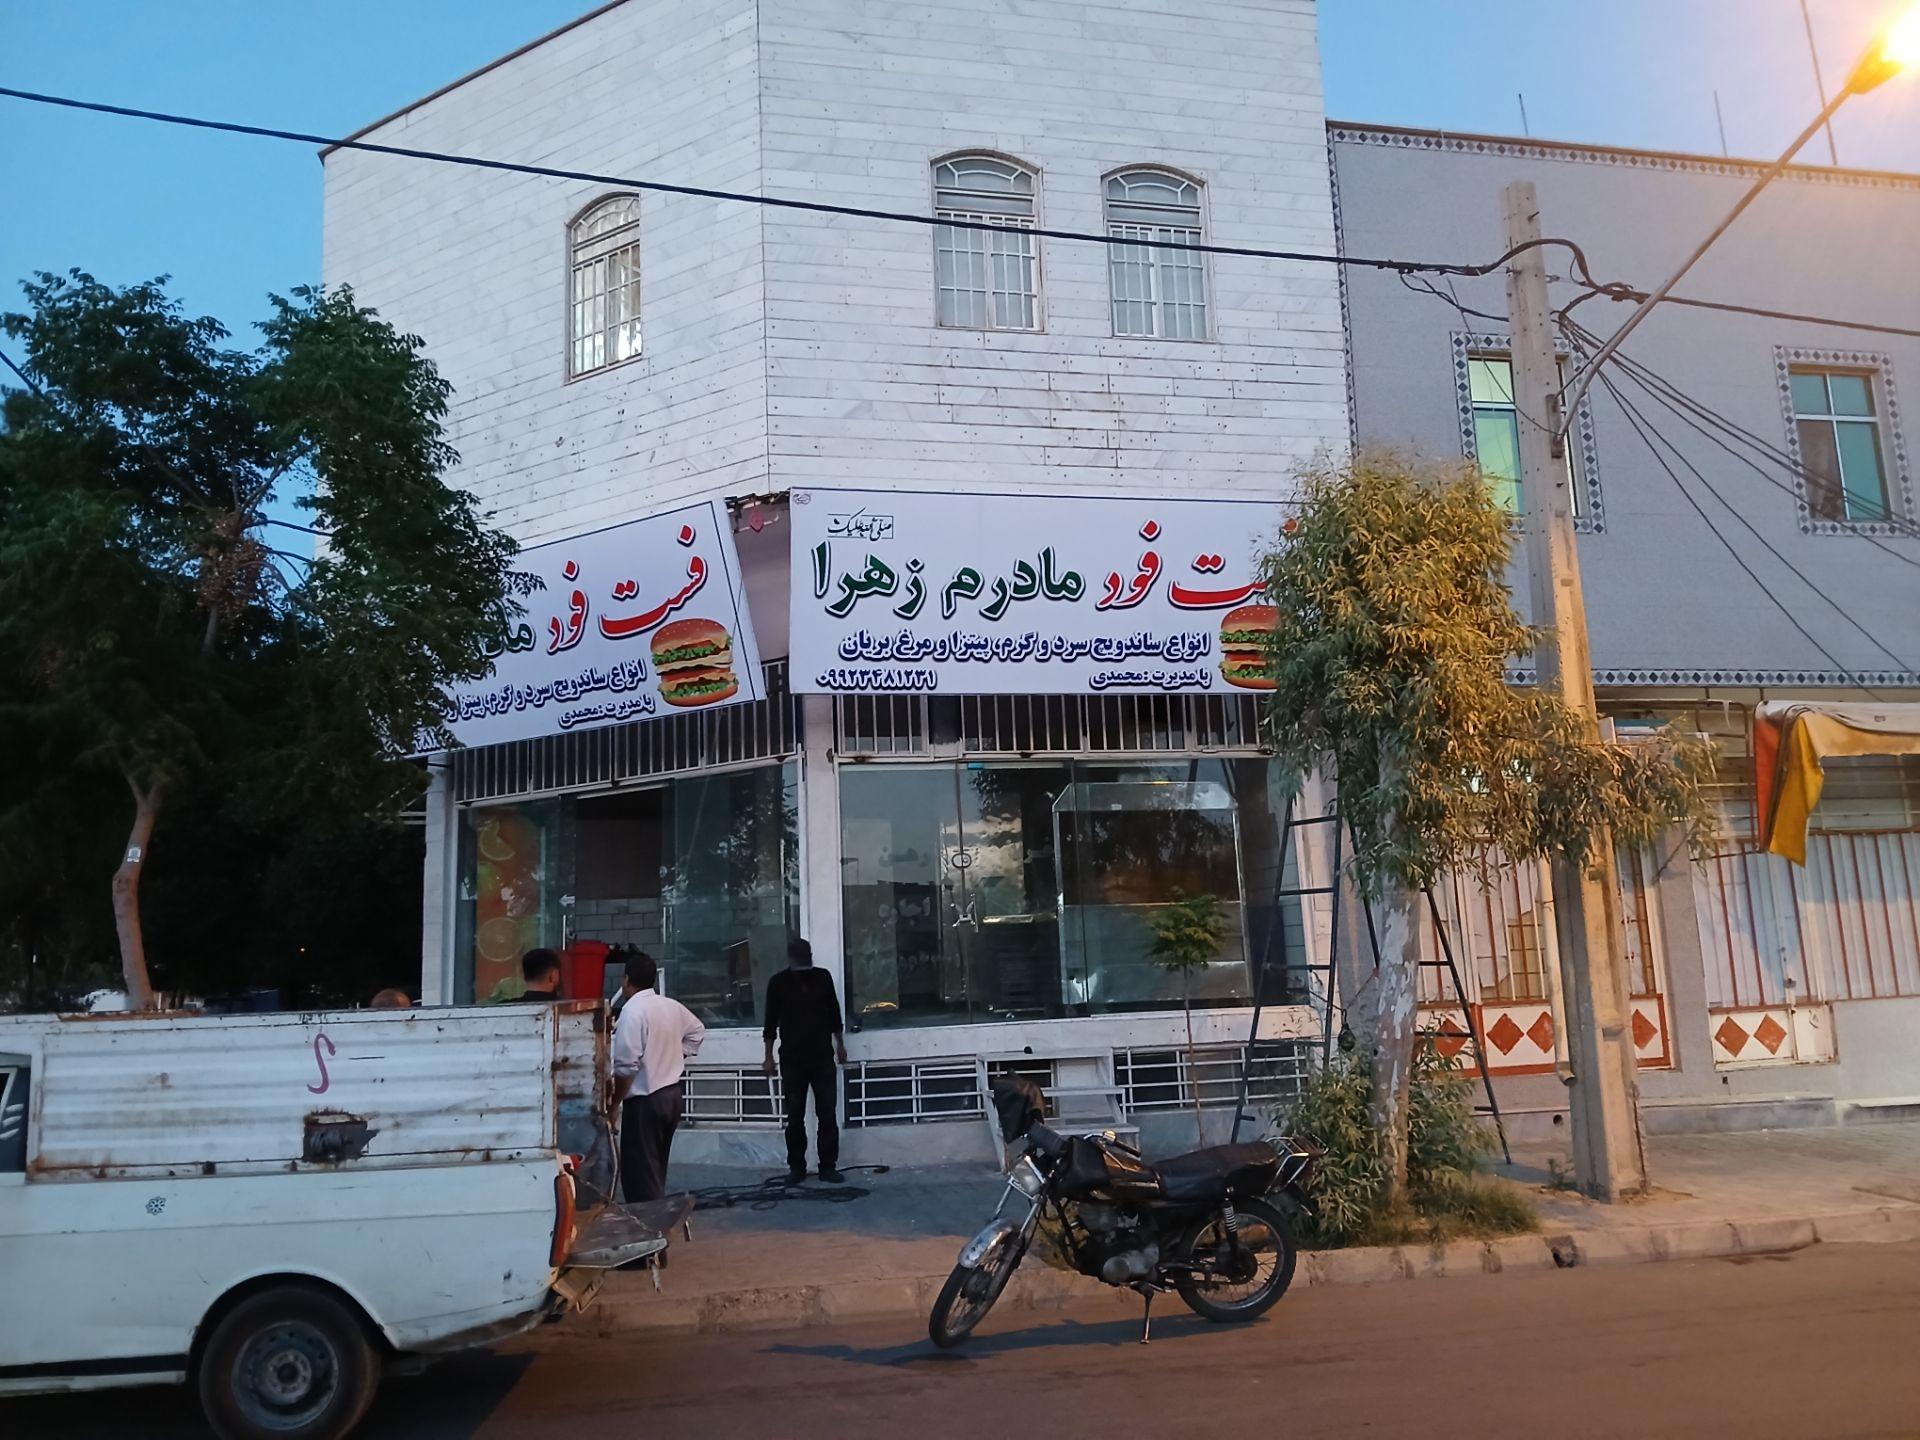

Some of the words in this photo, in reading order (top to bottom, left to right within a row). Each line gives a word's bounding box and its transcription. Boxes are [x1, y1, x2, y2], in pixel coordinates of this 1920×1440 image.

[811, 540, 926, 620] زهرا
[1096, 520, 1162, 611] فود
[599, 524, 708, 639] فست
[941, 546, 1086, 622] مادرم
[547, 560, 589, 654] فود
[840, 629, 893, 661] بریان
[894, 629, 932, 661] مرغ
[932, 637, 951, 662] و
[951, 630, 992, 662] پیتزا
[992, 631, 1037, 662] گرم،
[1037, 639, 1051, 662] و
[1052, 633, 1089, 662] سرد
[1089, 632, 1162, 662] ساندویچ
[1163, 632, 1211, 662] انواع
[552, 667, 609, 702] ساندویچ
[609, 658, 647, 693] انواع
[816, 668, 938, 690] ۰۹۹۲۳۴۸۱۲۳۱
[1198, 668, 1212, 690] با
[514, 688, 525, 711] و
[524, 683, 553, 709] سرد
[641, 693, 656, 714] با
